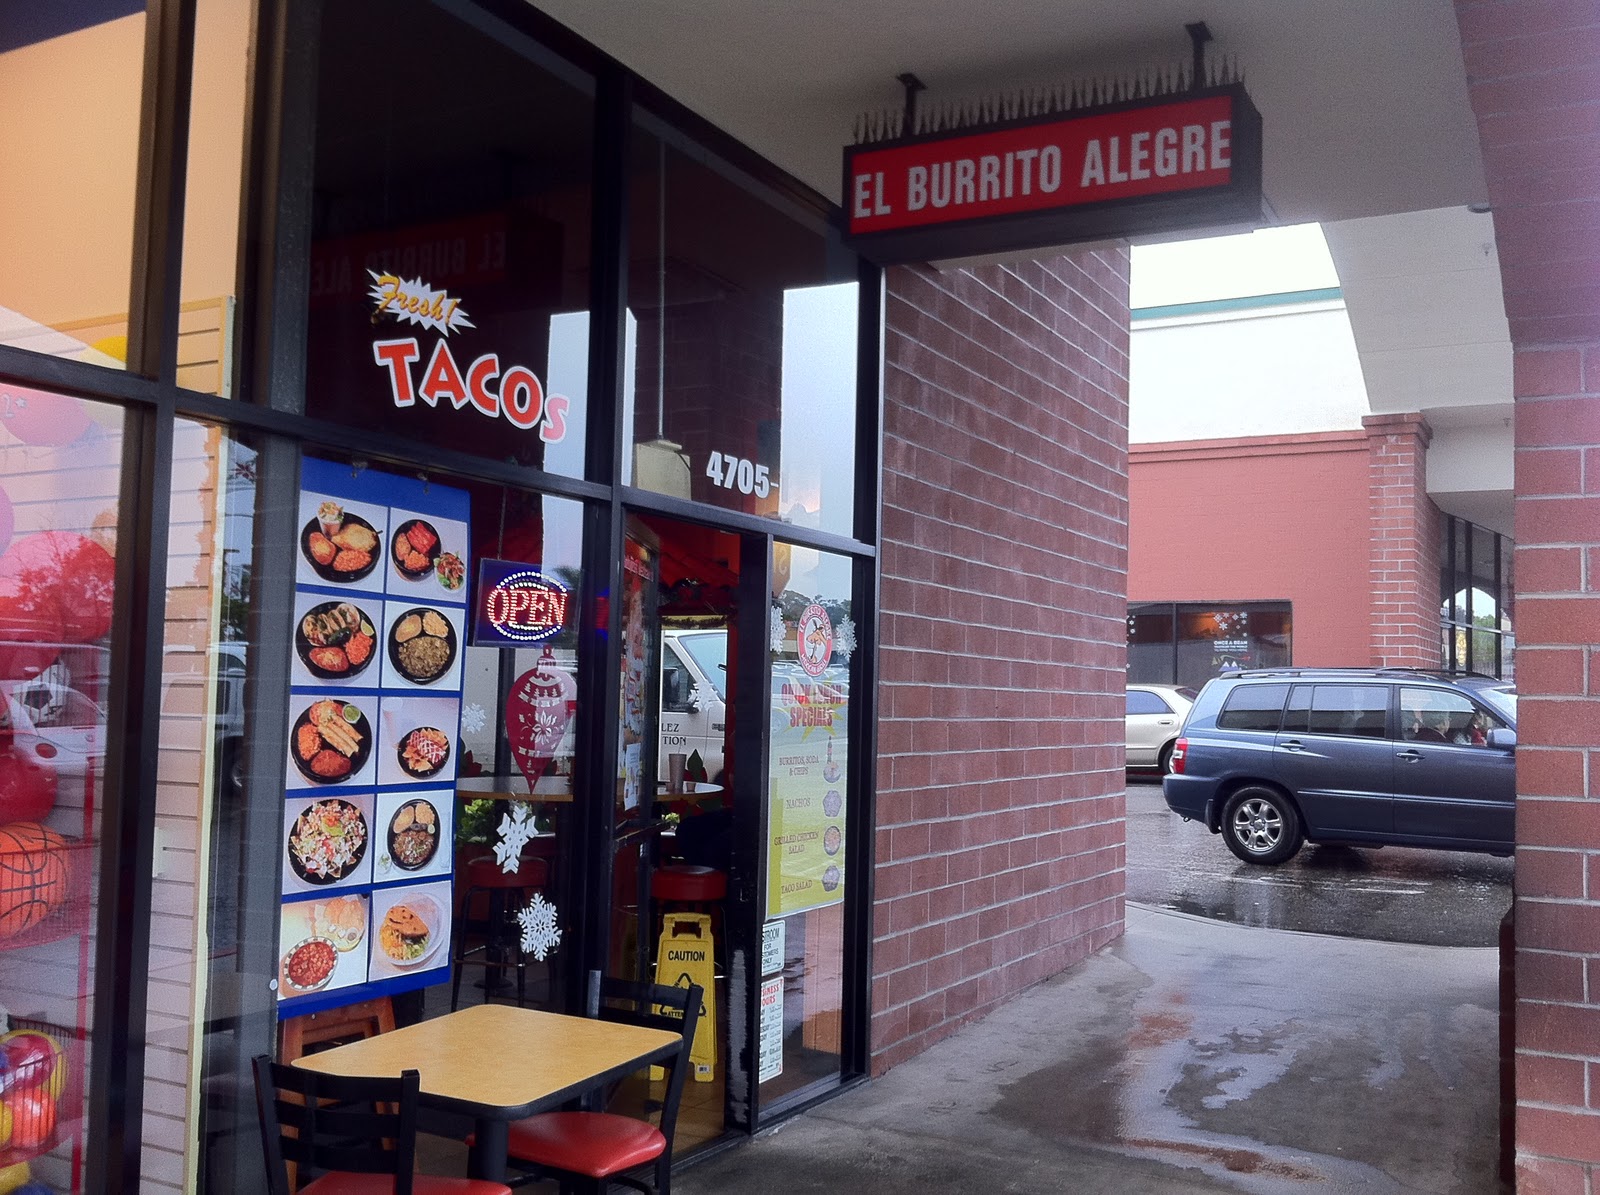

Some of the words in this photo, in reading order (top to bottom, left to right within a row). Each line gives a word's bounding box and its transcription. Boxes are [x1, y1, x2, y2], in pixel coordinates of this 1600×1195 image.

[853, 172, 891, 219] EL
[907, 145, 1062, 212] BURRITO
[1079, 120, 1232, 188] ALEGRE
[370, 275, 459, 325] Fresh!
[373, 337, 570, 445] TACOS
[487, 588, 568, 625] OPEN
[661, 723, 680, 732] LEZ
[789, 706, 833, 728] SPECIALS
[668, 950, 705, 962] CAUTION
